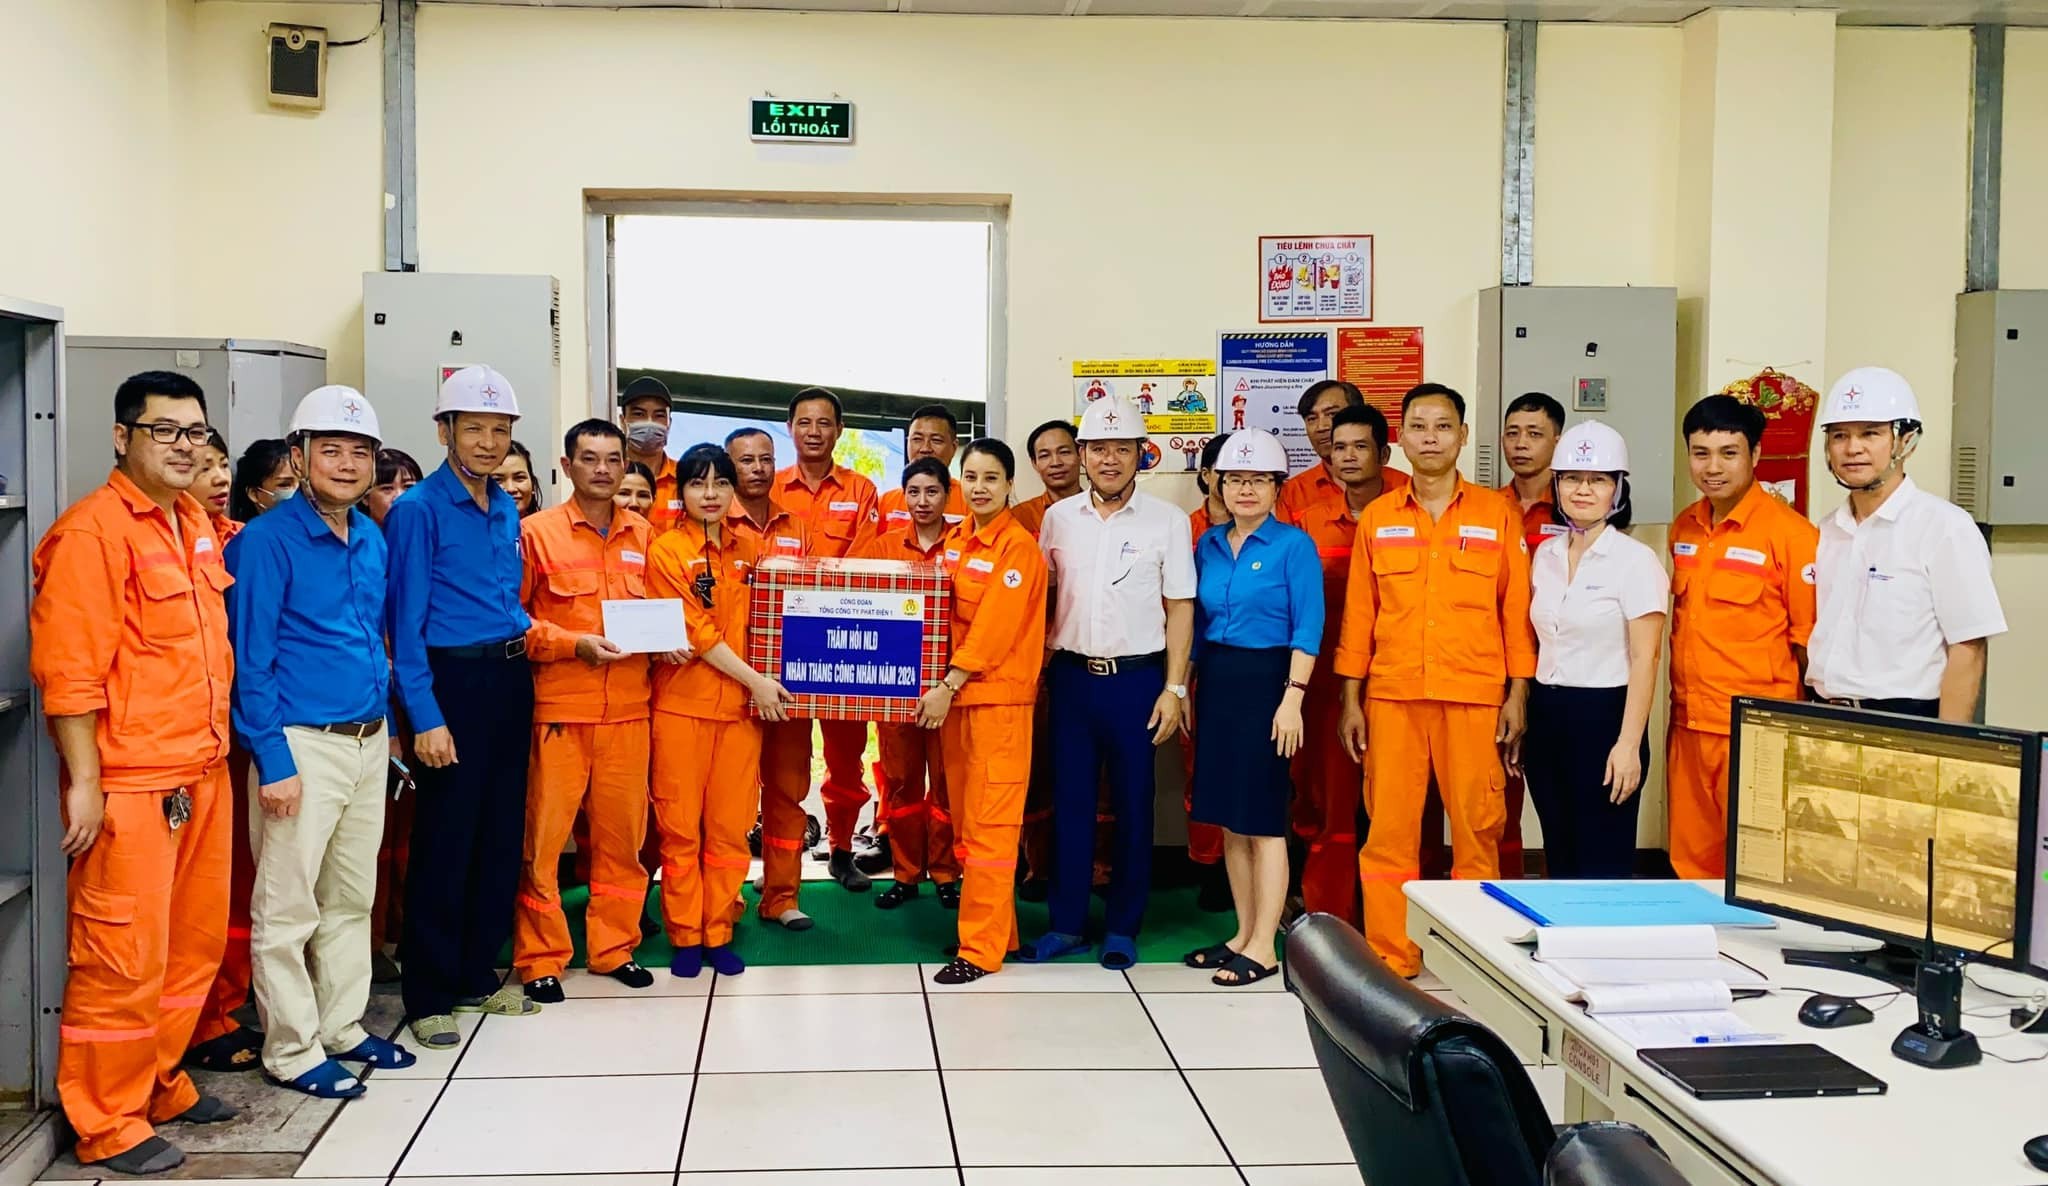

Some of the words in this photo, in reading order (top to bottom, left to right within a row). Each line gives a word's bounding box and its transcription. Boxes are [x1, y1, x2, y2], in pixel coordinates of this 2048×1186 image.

[769, 103, 832, 117] EXIT
[762, 117, 785, 134] LỐI
[789, 121, 839, 135] THOÁT
[835, 606, 852, 615] CÔNG
[840, 597, 857, 606] CÔNG
[826, 625, 849, 649] THĂM
[849, 624, 862, 650] HỎI
[785, 657, 808, 682] NHÂN
[808, 658, 833, 683] THÁNG
[834, 659, 855, 684] CÔNG
[856, 660, 878, 685] NHÂN
[878, 661, 897, 686] NĂM
[897, 666, 916, 687] 2024
[1568, 1051, 1601, 1086] CONSOLE
